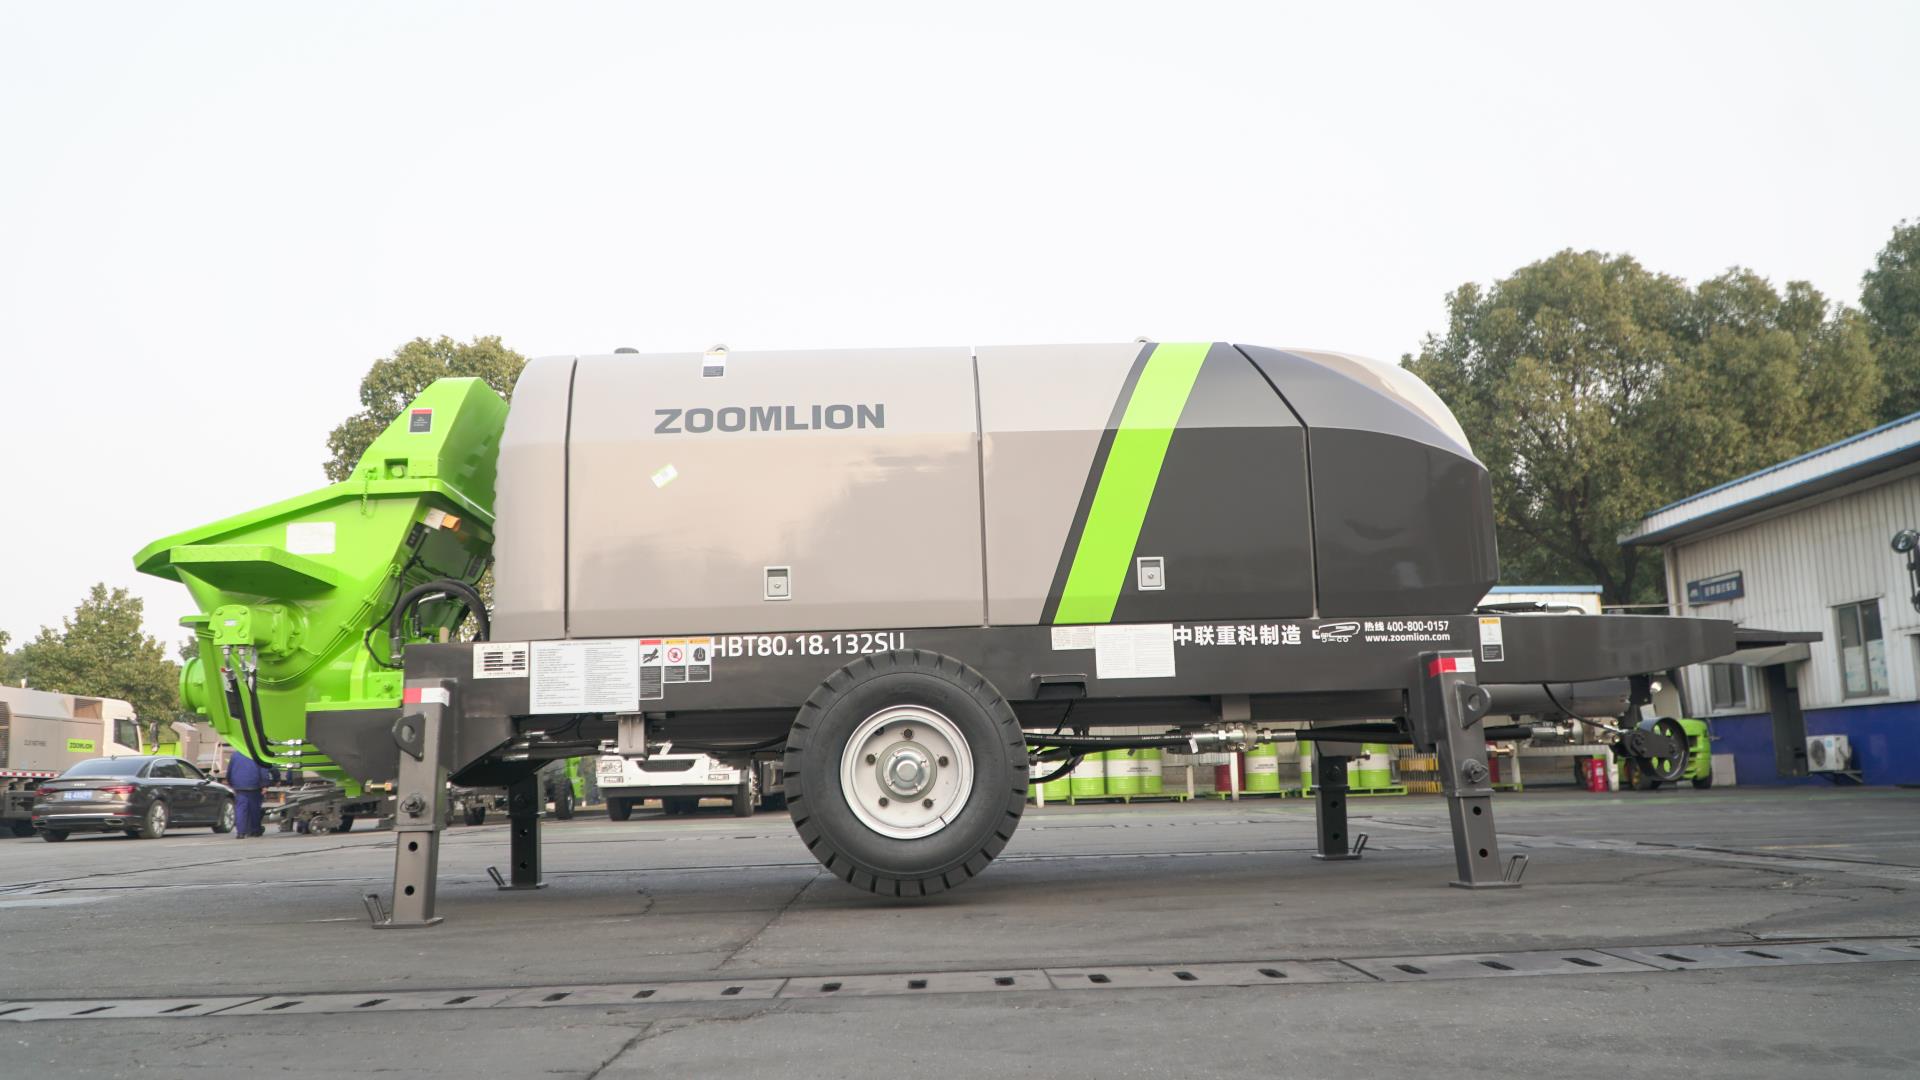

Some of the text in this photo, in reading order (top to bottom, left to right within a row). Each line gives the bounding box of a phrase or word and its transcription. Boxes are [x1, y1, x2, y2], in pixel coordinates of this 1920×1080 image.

[654, 404, 885, 434] ZOOMLION
[1173, 624, 1301, 646] 中联重科制造
[1364, 621, 1385, 632] 热线
[1387, 620, 1449, 632] 400-800-0157
[711, 632, 905, 657] HBT80.18.132SU
[1365, 632, 1451, 643] www.zoomlion.com
